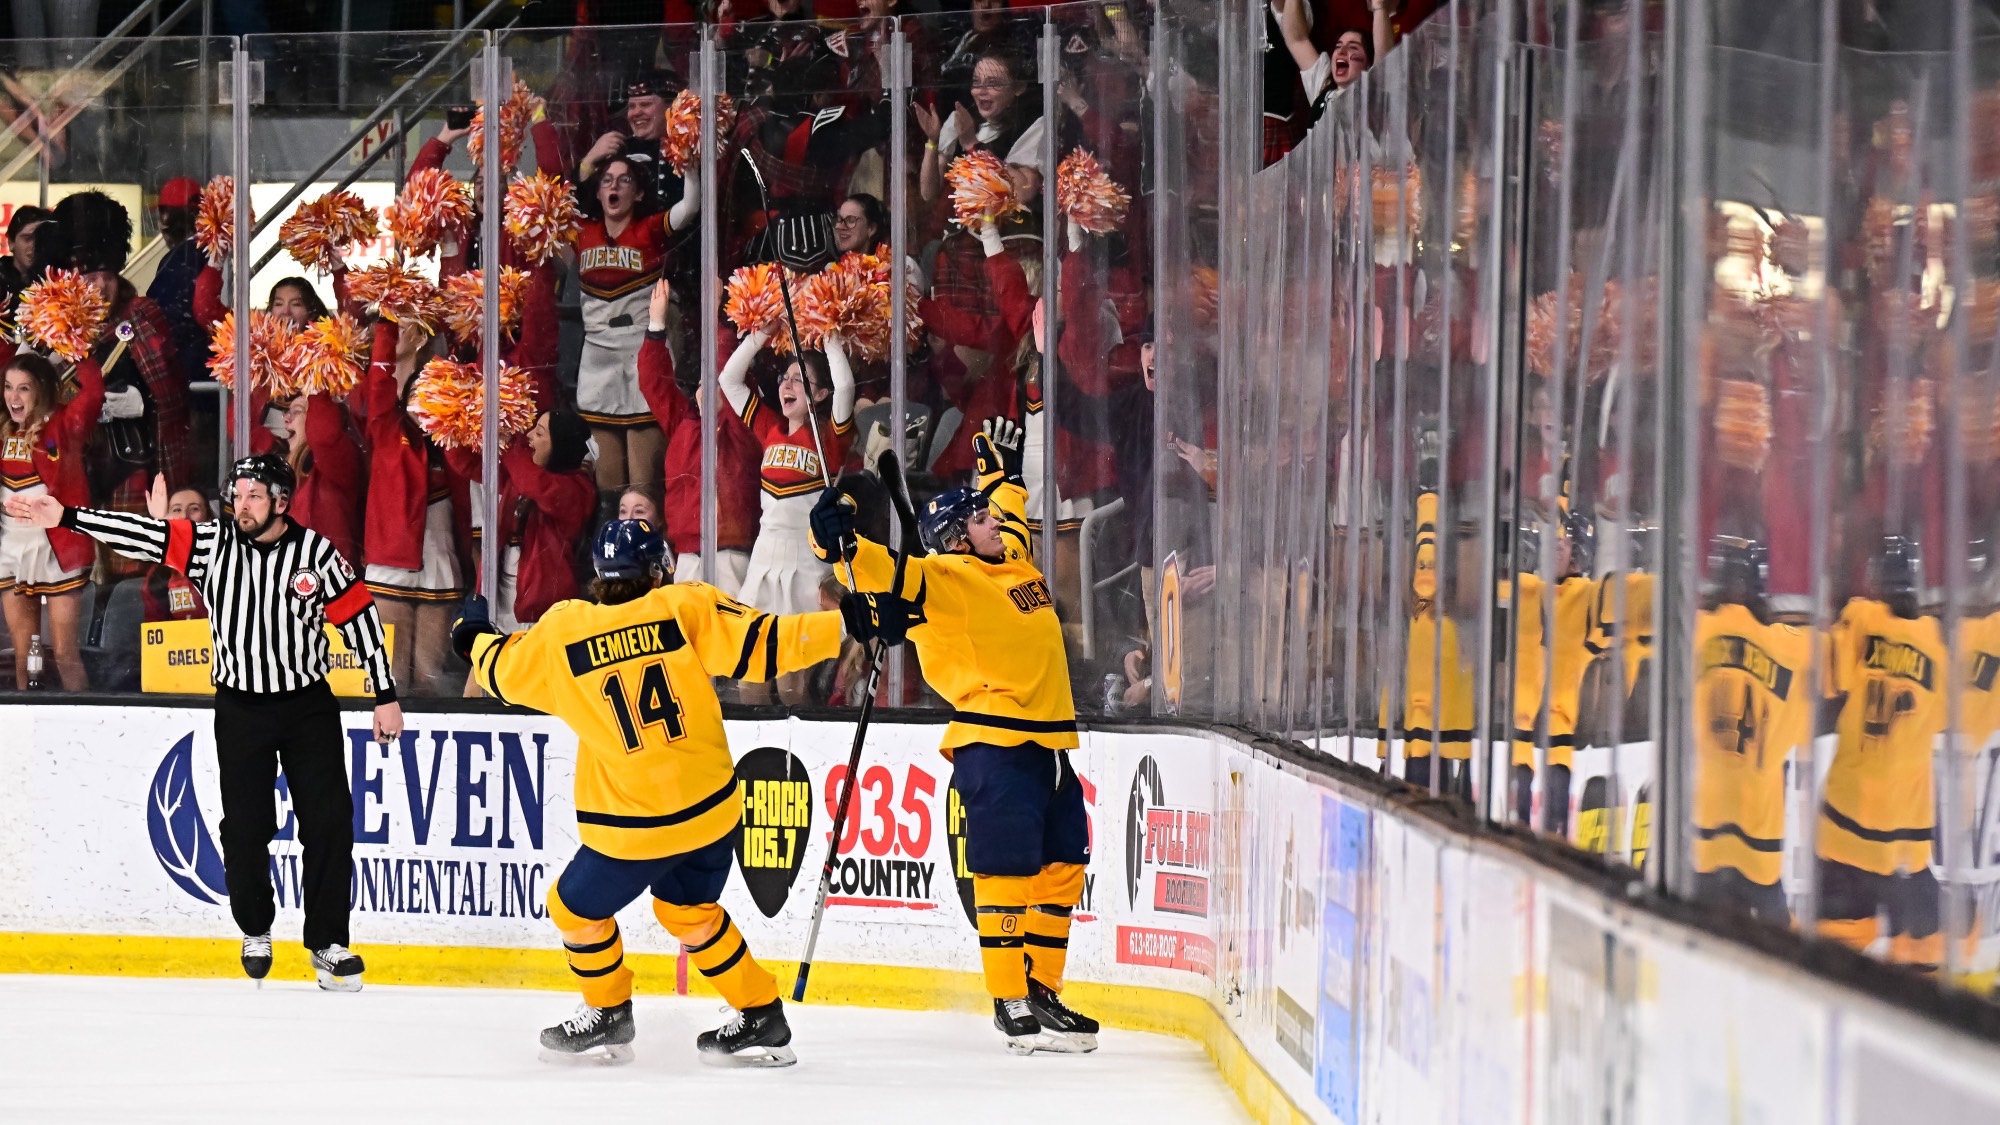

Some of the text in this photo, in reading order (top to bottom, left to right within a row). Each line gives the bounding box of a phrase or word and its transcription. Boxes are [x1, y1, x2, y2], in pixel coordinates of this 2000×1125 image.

[147, 628, 164, 646] GO
[168, 647, 210, 667] GAELS
[586, 623, 665, 668] LEMIEUX
[328, 653, 357, 670] GAEL
[600, 657, 688, 755] 14
[824, 763, 937, 859] 93.5
[743, 827, 797, 869] 105.7
[828, 856, 936, 899] COUNTRY
